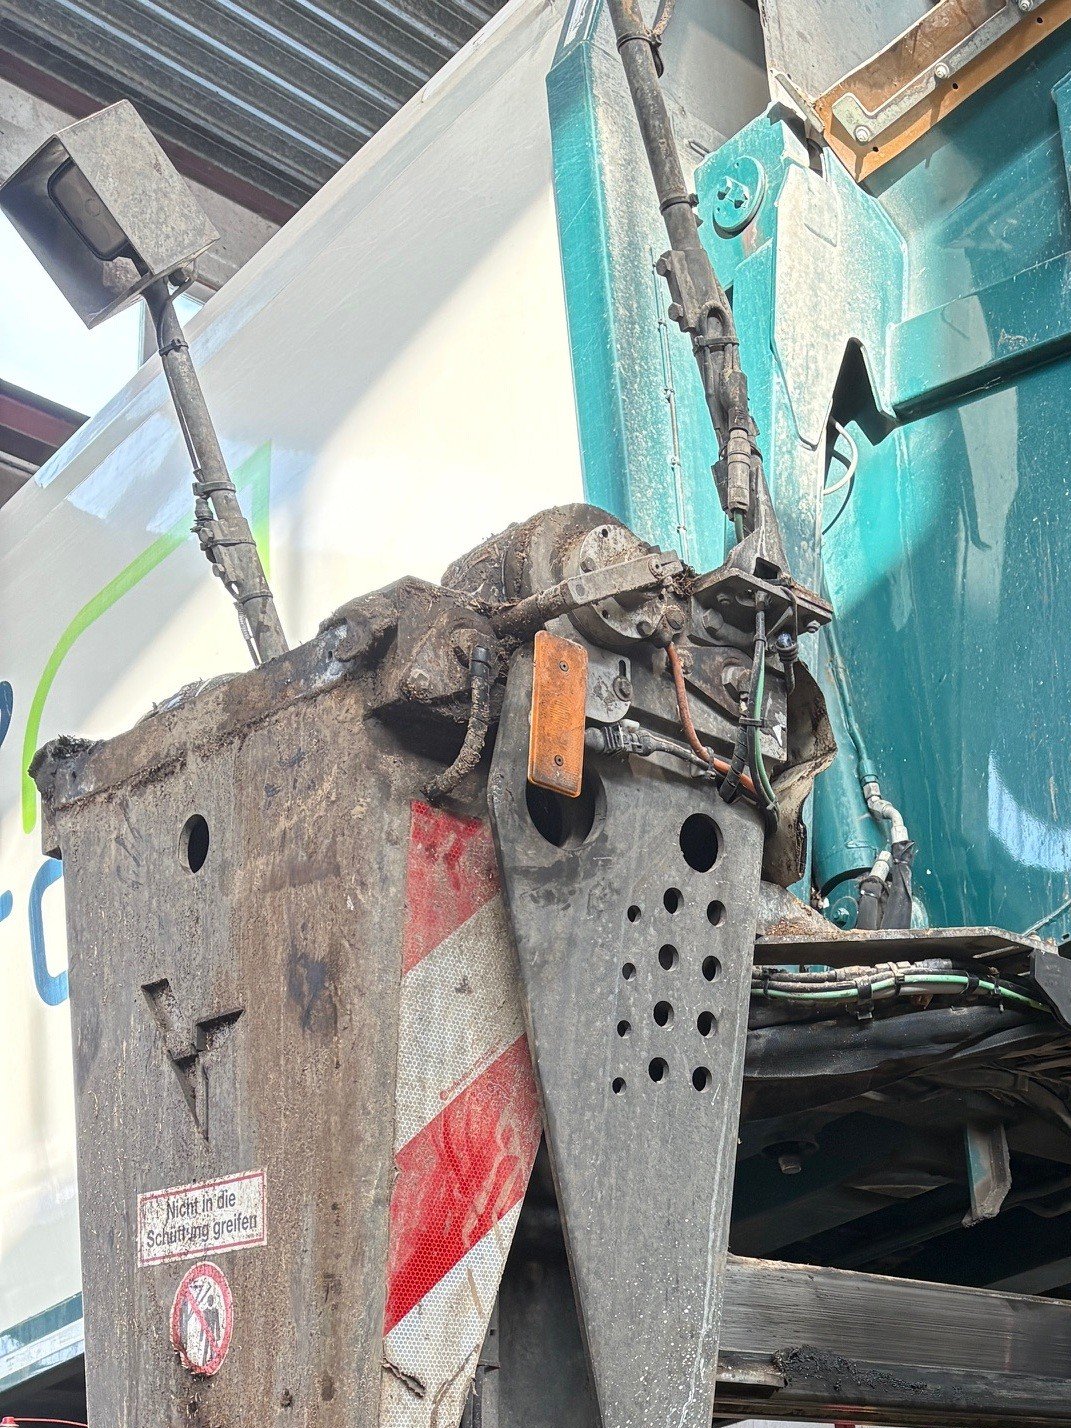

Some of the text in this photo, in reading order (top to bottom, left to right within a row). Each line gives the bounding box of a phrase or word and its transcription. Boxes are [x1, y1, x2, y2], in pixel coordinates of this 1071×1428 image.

[167, 1189, 236, 1219] Nicht in die
[213, 1213, 257, 1241] greifen
